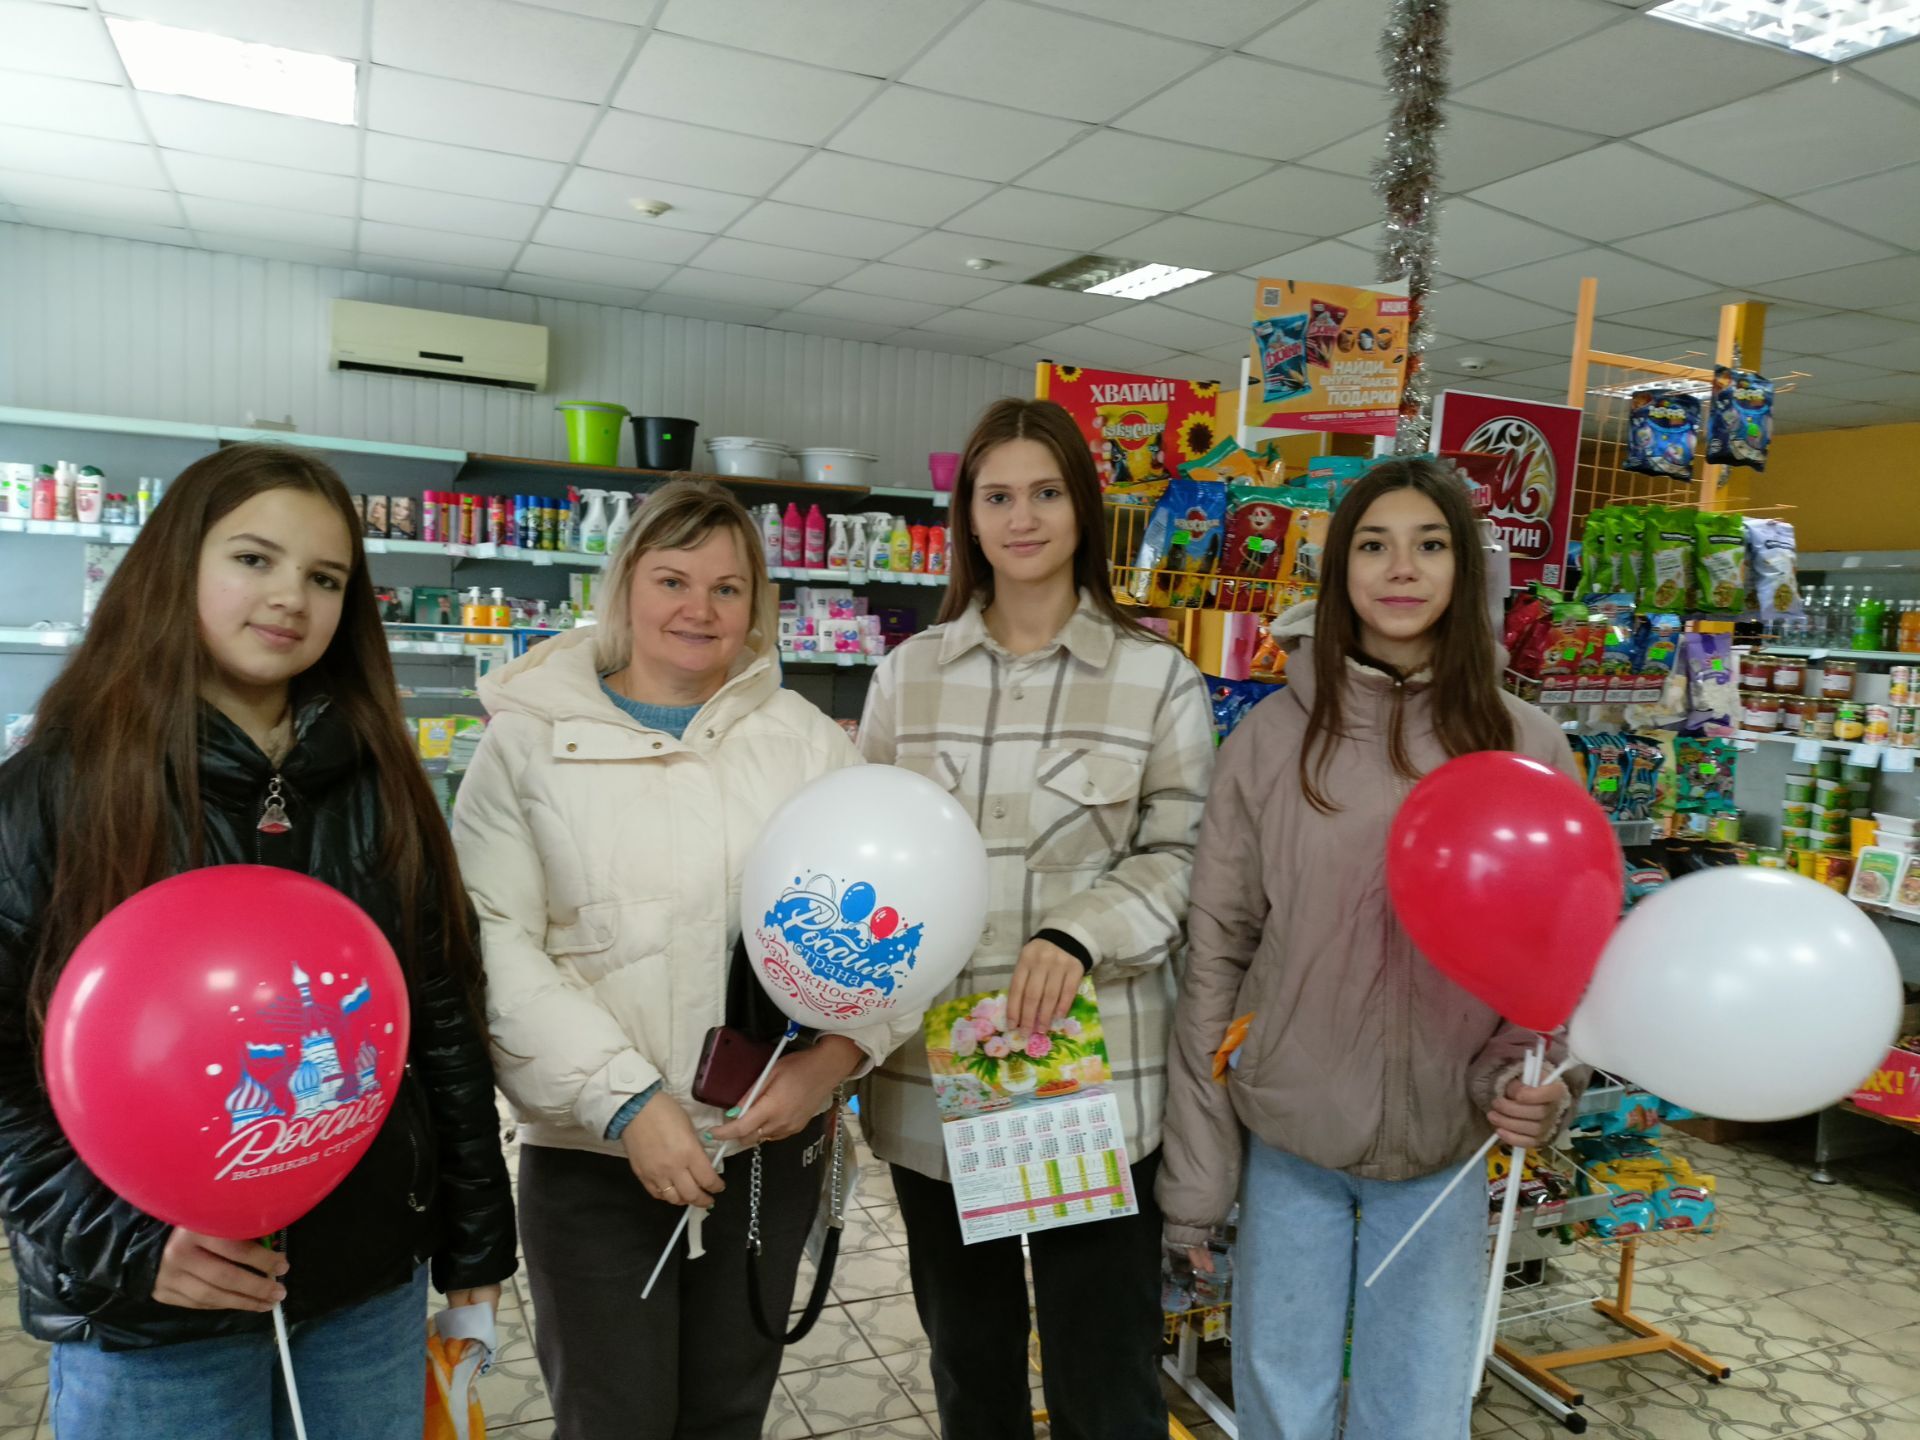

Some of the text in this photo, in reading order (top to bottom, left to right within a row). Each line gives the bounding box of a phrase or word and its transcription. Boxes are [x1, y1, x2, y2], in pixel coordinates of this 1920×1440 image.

[1333, 359, 1384, 376] НАЙДИ
[1090, 379, 1176, 403] ХВАТАЙ!
[1328, 391, 1397, 406] ПОДАРКИ
[1492, 526, 1541, 549] РТИН
[781, 891, 891, 979] Россия
[793, 943, 861, 987] страна
[214, 1091, 386, 1181] Россия
[231, 1152, 320, 1181] великая
